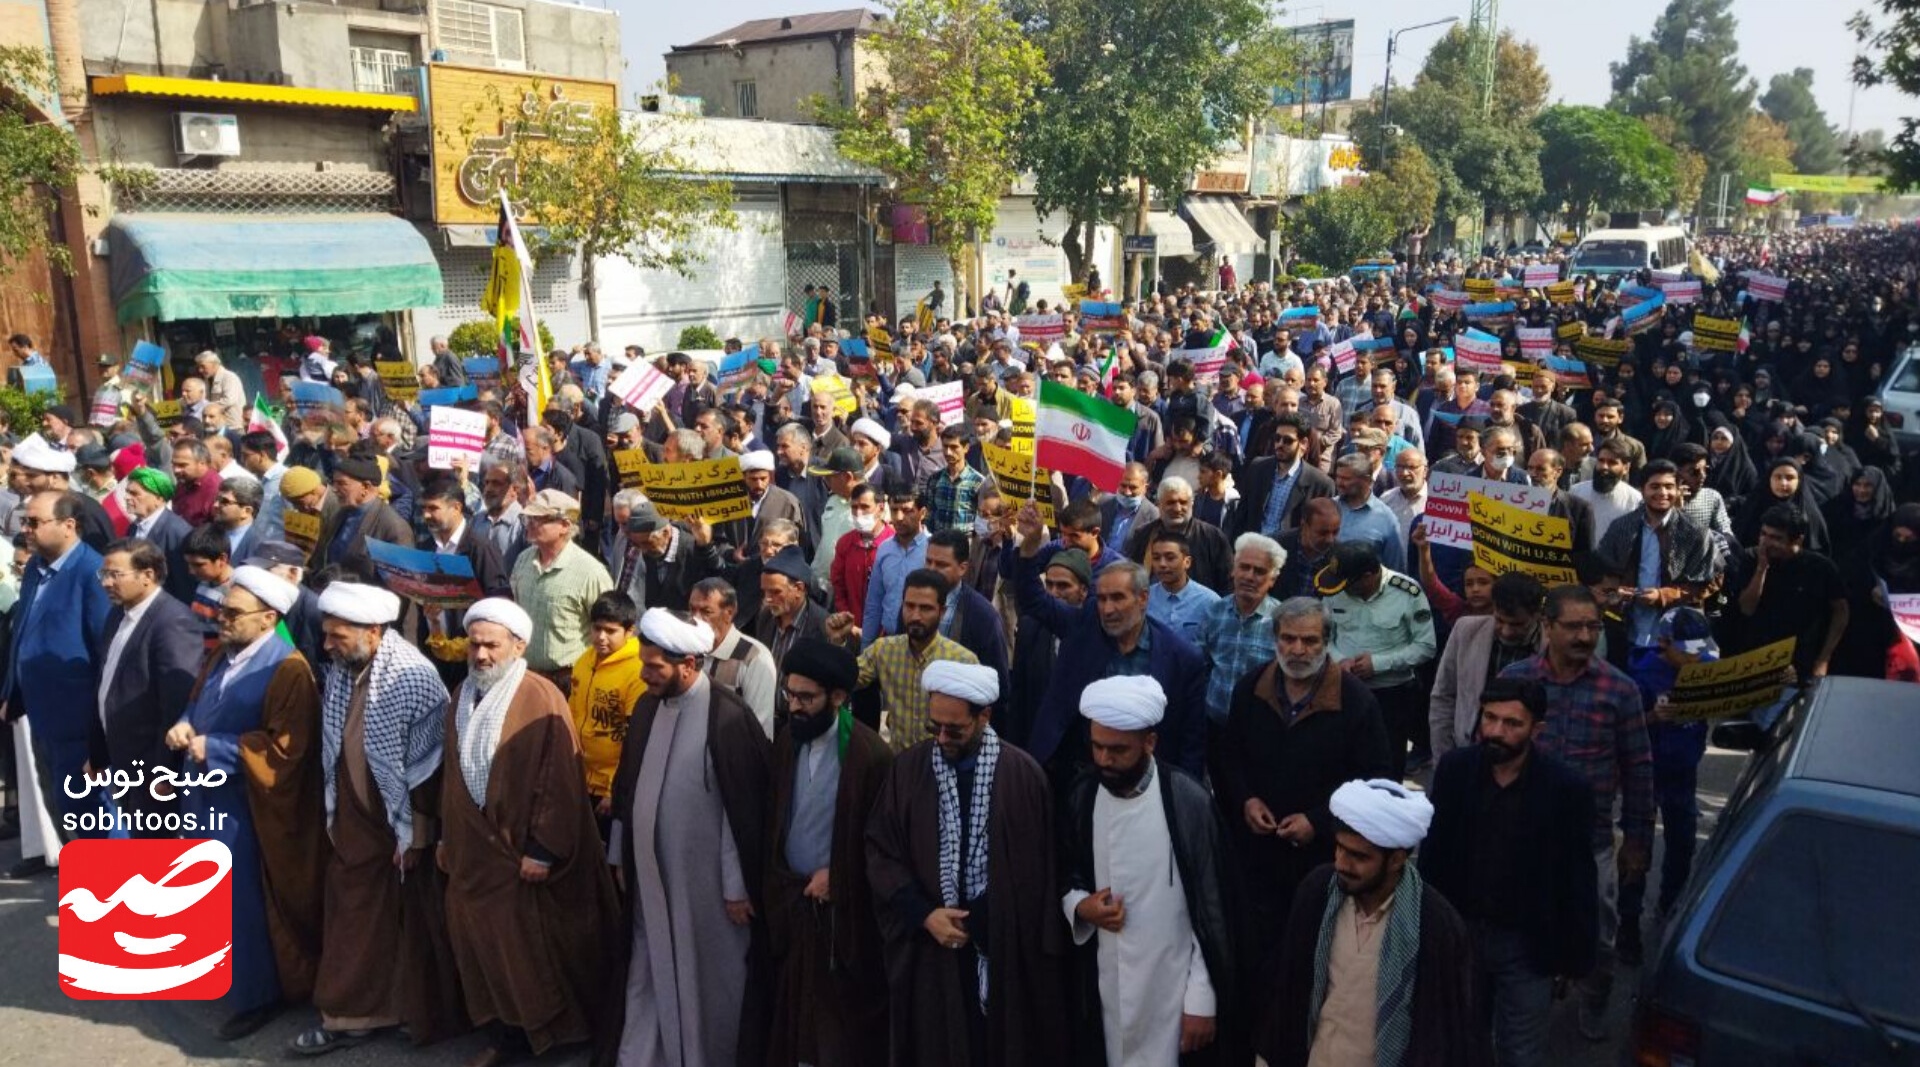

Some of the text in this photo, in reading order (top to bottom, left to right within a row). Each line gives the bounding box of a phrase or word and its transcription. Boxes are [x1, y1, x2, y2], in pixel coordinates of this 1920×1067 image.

[706, 464, 737, 480] مرگ
[677, 490, 704, 501] WITH
[706, 485, 744, 498] ISRAEL
[1426, 501, 1463, 515] DOWN
[1511, 523, 1523, 537] بر
[1529, 520, 1565, 543] مرگ
[1472, 526, 1501, 547] DOWN
[1501, 538, 1531, 557] WITH
